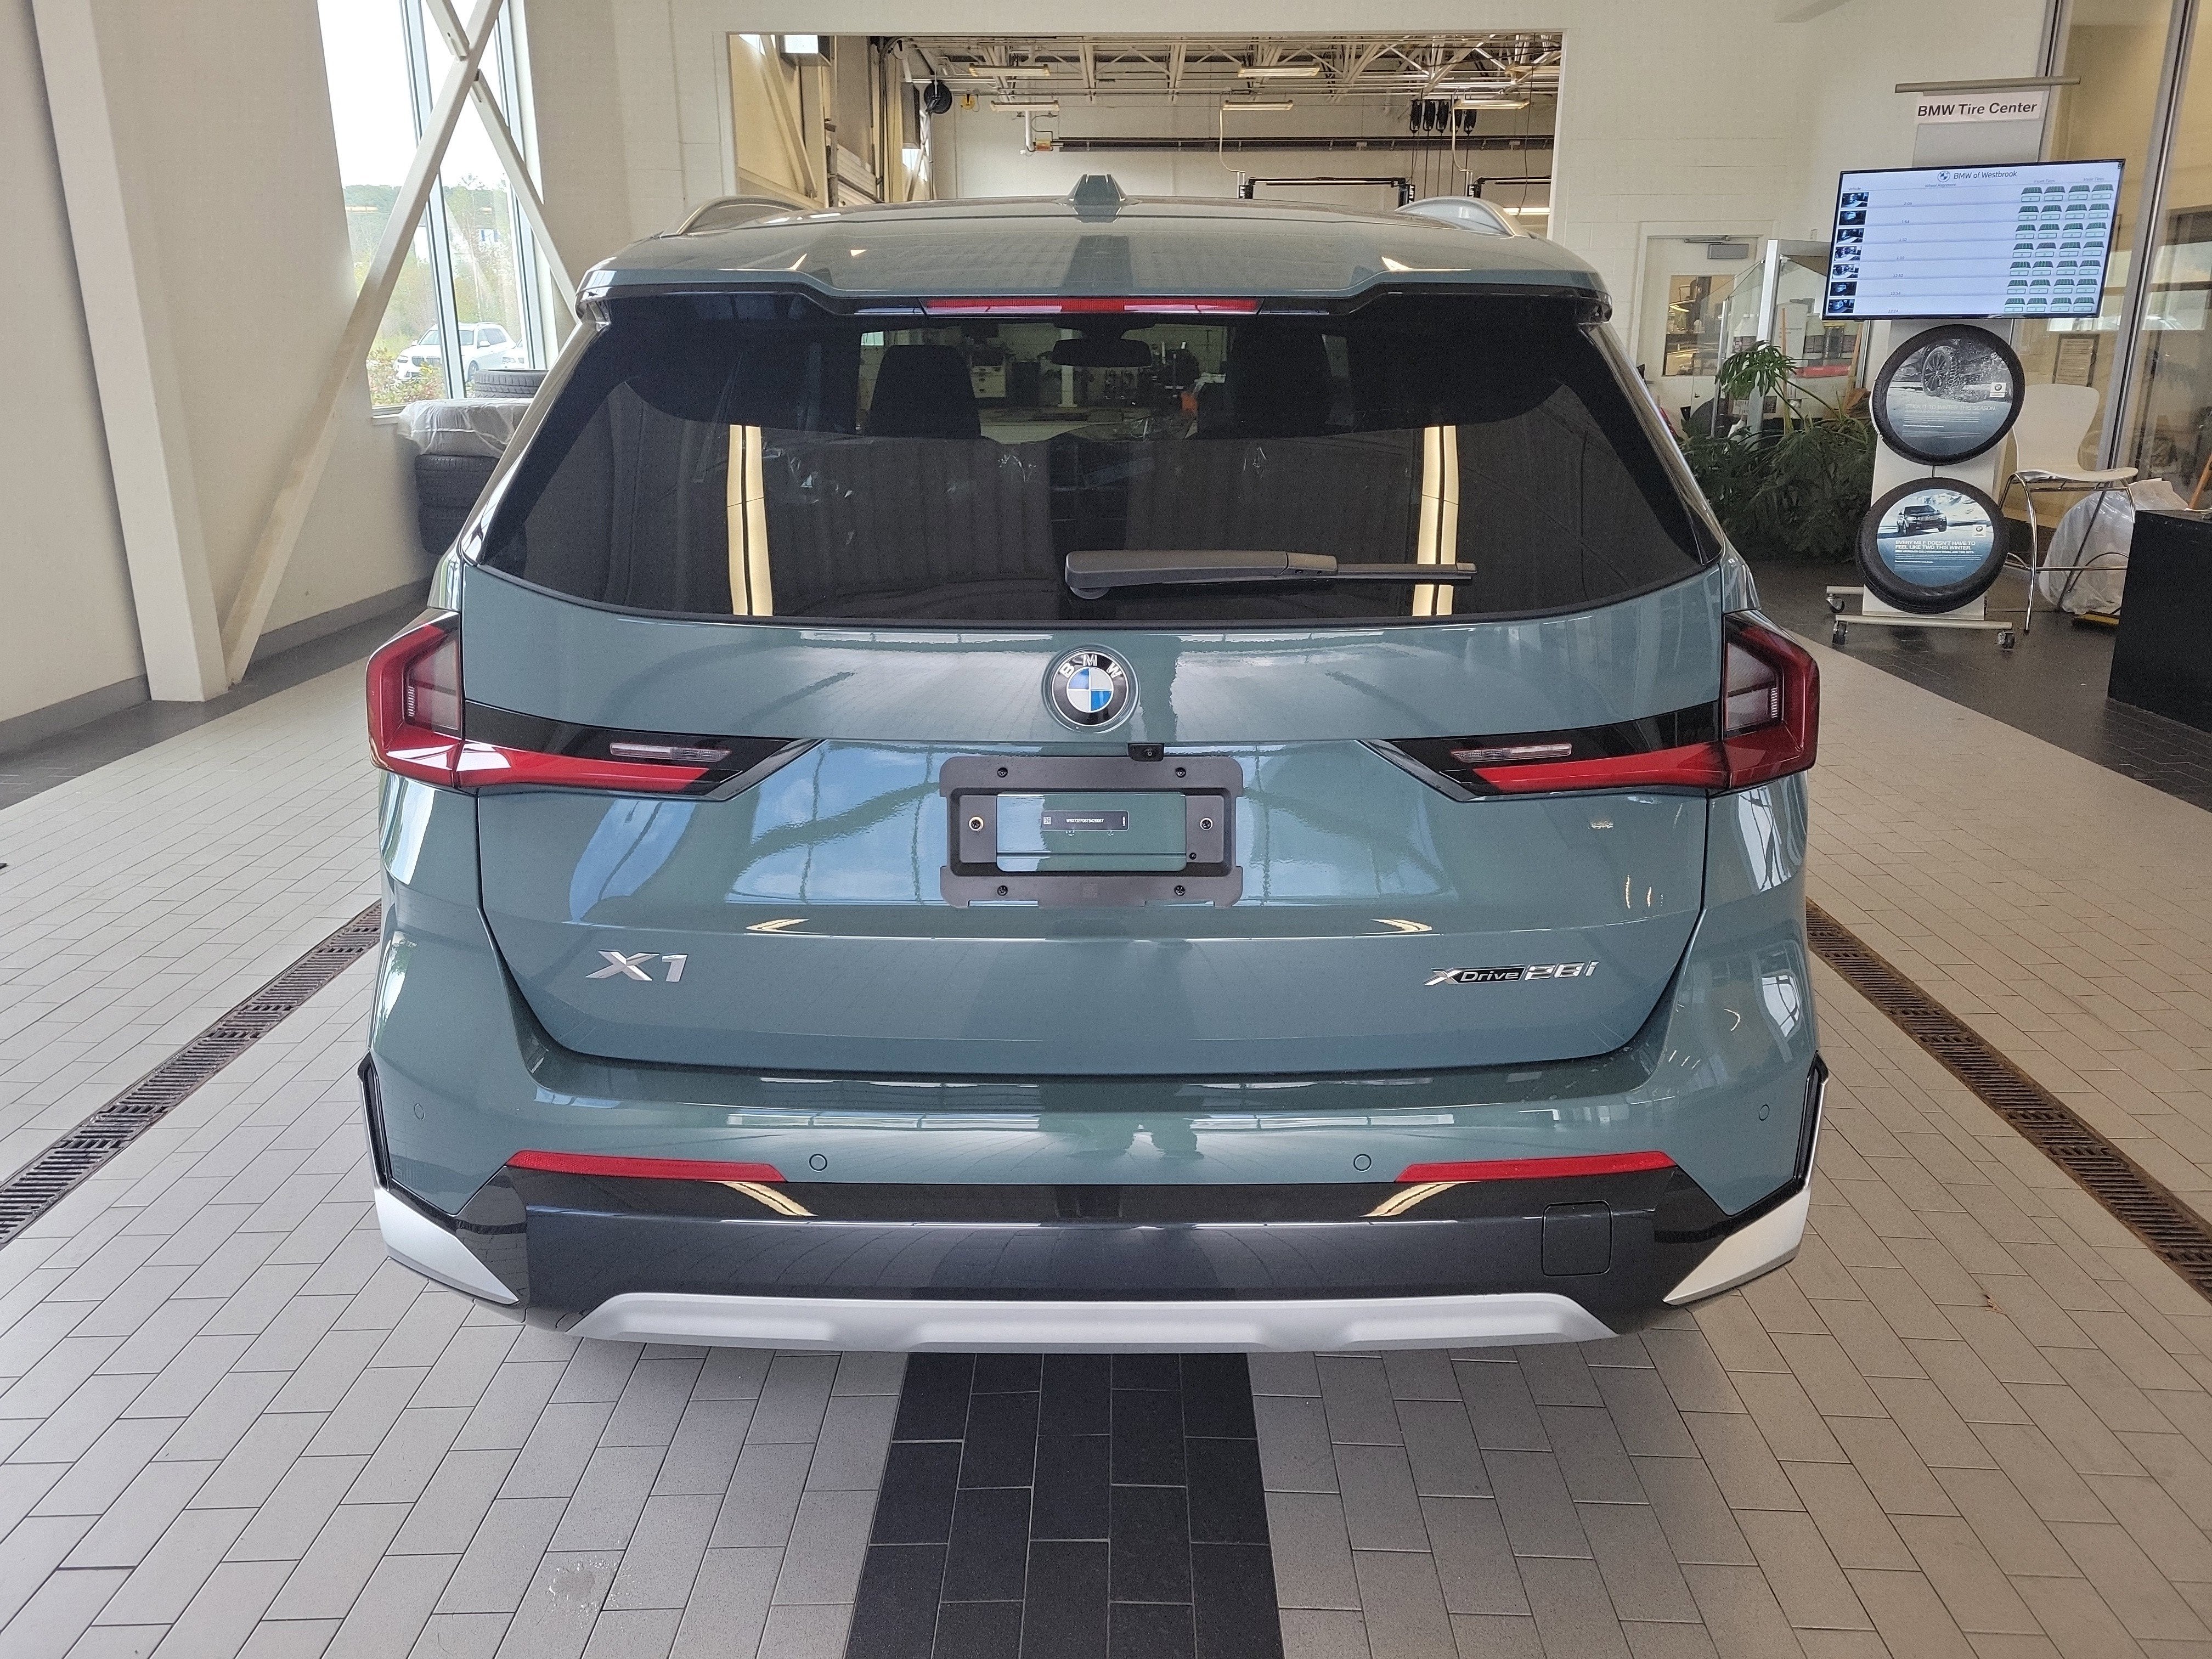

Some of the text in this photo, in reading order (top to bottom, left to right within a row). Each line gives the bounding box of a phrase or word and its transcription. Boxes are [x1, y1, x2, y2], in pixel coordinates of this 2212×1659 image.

[1917, 102, 2038, 116] BMW Tire Center
[1059, 653, 1122, 679] BMW
[585, 950, 688, 983] X1
